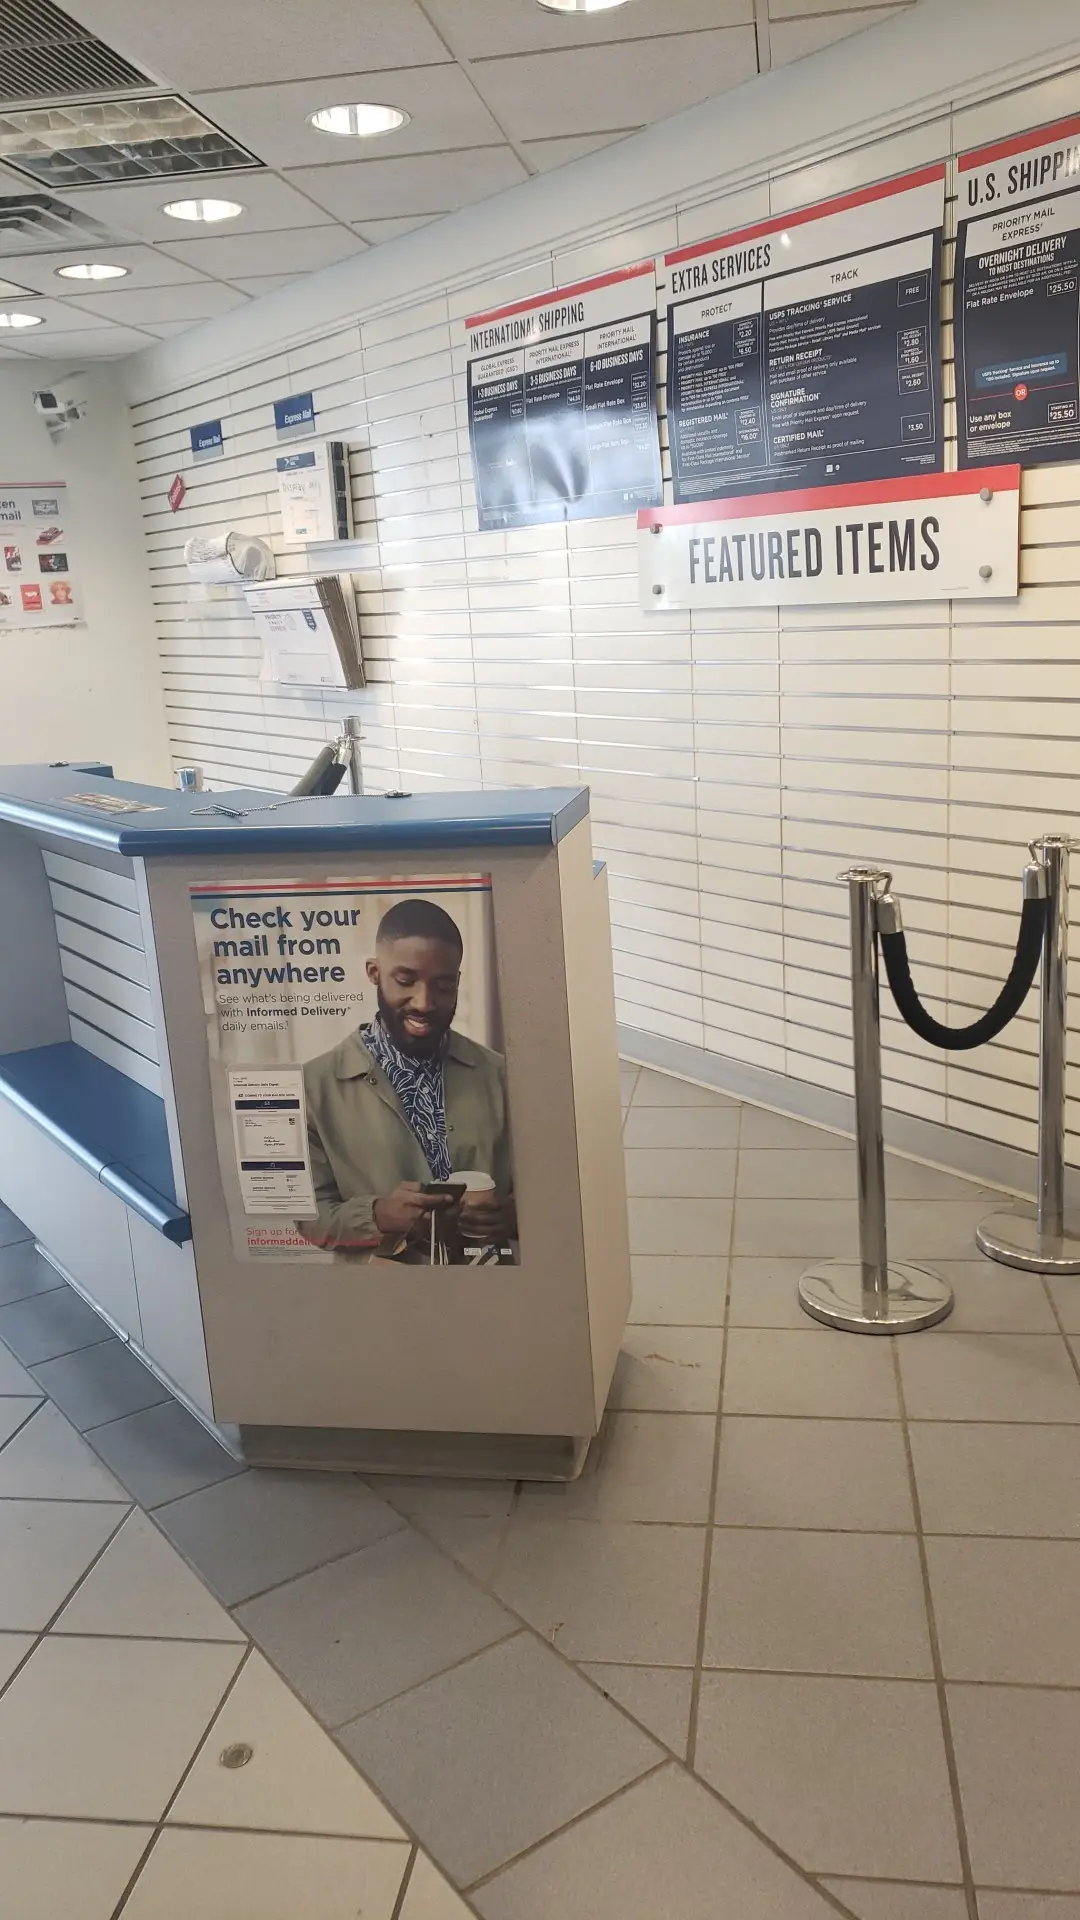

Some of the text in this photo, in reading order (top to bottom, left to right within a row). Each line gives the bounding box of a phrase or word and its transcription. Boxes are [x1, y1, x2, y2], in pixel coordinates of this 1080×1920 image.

[968, 172, 1001, 207] U.S.
[992, 205, 1055, 232] PRIORITY MAIL
[978, 245, 1024, 270] OVERNIGHT
[1025, 234, 1067, 258] DELIVERY
[671, 243, 771, 294] EXTRA SERVICES
[988, 266, 996, 277] TO
[996, 262, 1012, 275] MOST
[1013, 251, 1054, 270] DESTINATIONS
[829, 267, 859, 284] TRACK
[904, 285, 920, 296] FREE
[1049, 281, 1075, 294] $25.50
[966, 285, 1034, 309] Flat Rate Envelope
[700, 301, 732, 318] PROTECT
[768, 309, 785, 321] USPS
[822, 292, 852, 308] SERVICE
[470, 301, 585, 352] INTERNATIONAL SHIPPING
[599, 324, 635, 341] PRIORITY MAIL
[678, 329, 710, 344] INSURANCE
[528, 347, 547, 358] PRIORITY
[559, 339, 580, 350] EXPRESS
[768, 347, 823, 367] RETURN RECEIPT
[589, 348, 644, 372] 6-10 BUSINESS DAYS
[529, 373, 539, 386] 3-5
[537, 367, 563, 384] BUSINESS
[562, 364, 577, 379] DAYS
[603, 376, 624, 387] Envelope
[483, 382, 506, 397] BUSINESS
[505, 379, 518, 392] DAYS
[769, 386, 806, 401] SIGNATURE
[1014, 388, 1026, 397] OR
[284, 408, 312, 424] Express Mail
[678, 414, 712, 427] REGISTERED
[969, 409, 1011, 423] Use any box
[1049, 408, 1074, 420] $25.50
[907, 422, 924, 432] $3.50
[978, 419, 1011, 432] envelope
[772, 431, 805, 444] CERTIFIED
[688, 515, 940, 584] FEATURED ITEMS
[210, 906, 361, 932] Check your
[213, 934, 341, 958] mail from
[216, 962, 346, 988] anywhere
[219, 992, 364, 1004] See what's being delivered
[221, 1007, 244, 1018] with
[246, 1007, 298, 1017] Informed
[222, 1021, 247, 1033] daily
[246, 1227, 299, 1237] Sign up for
